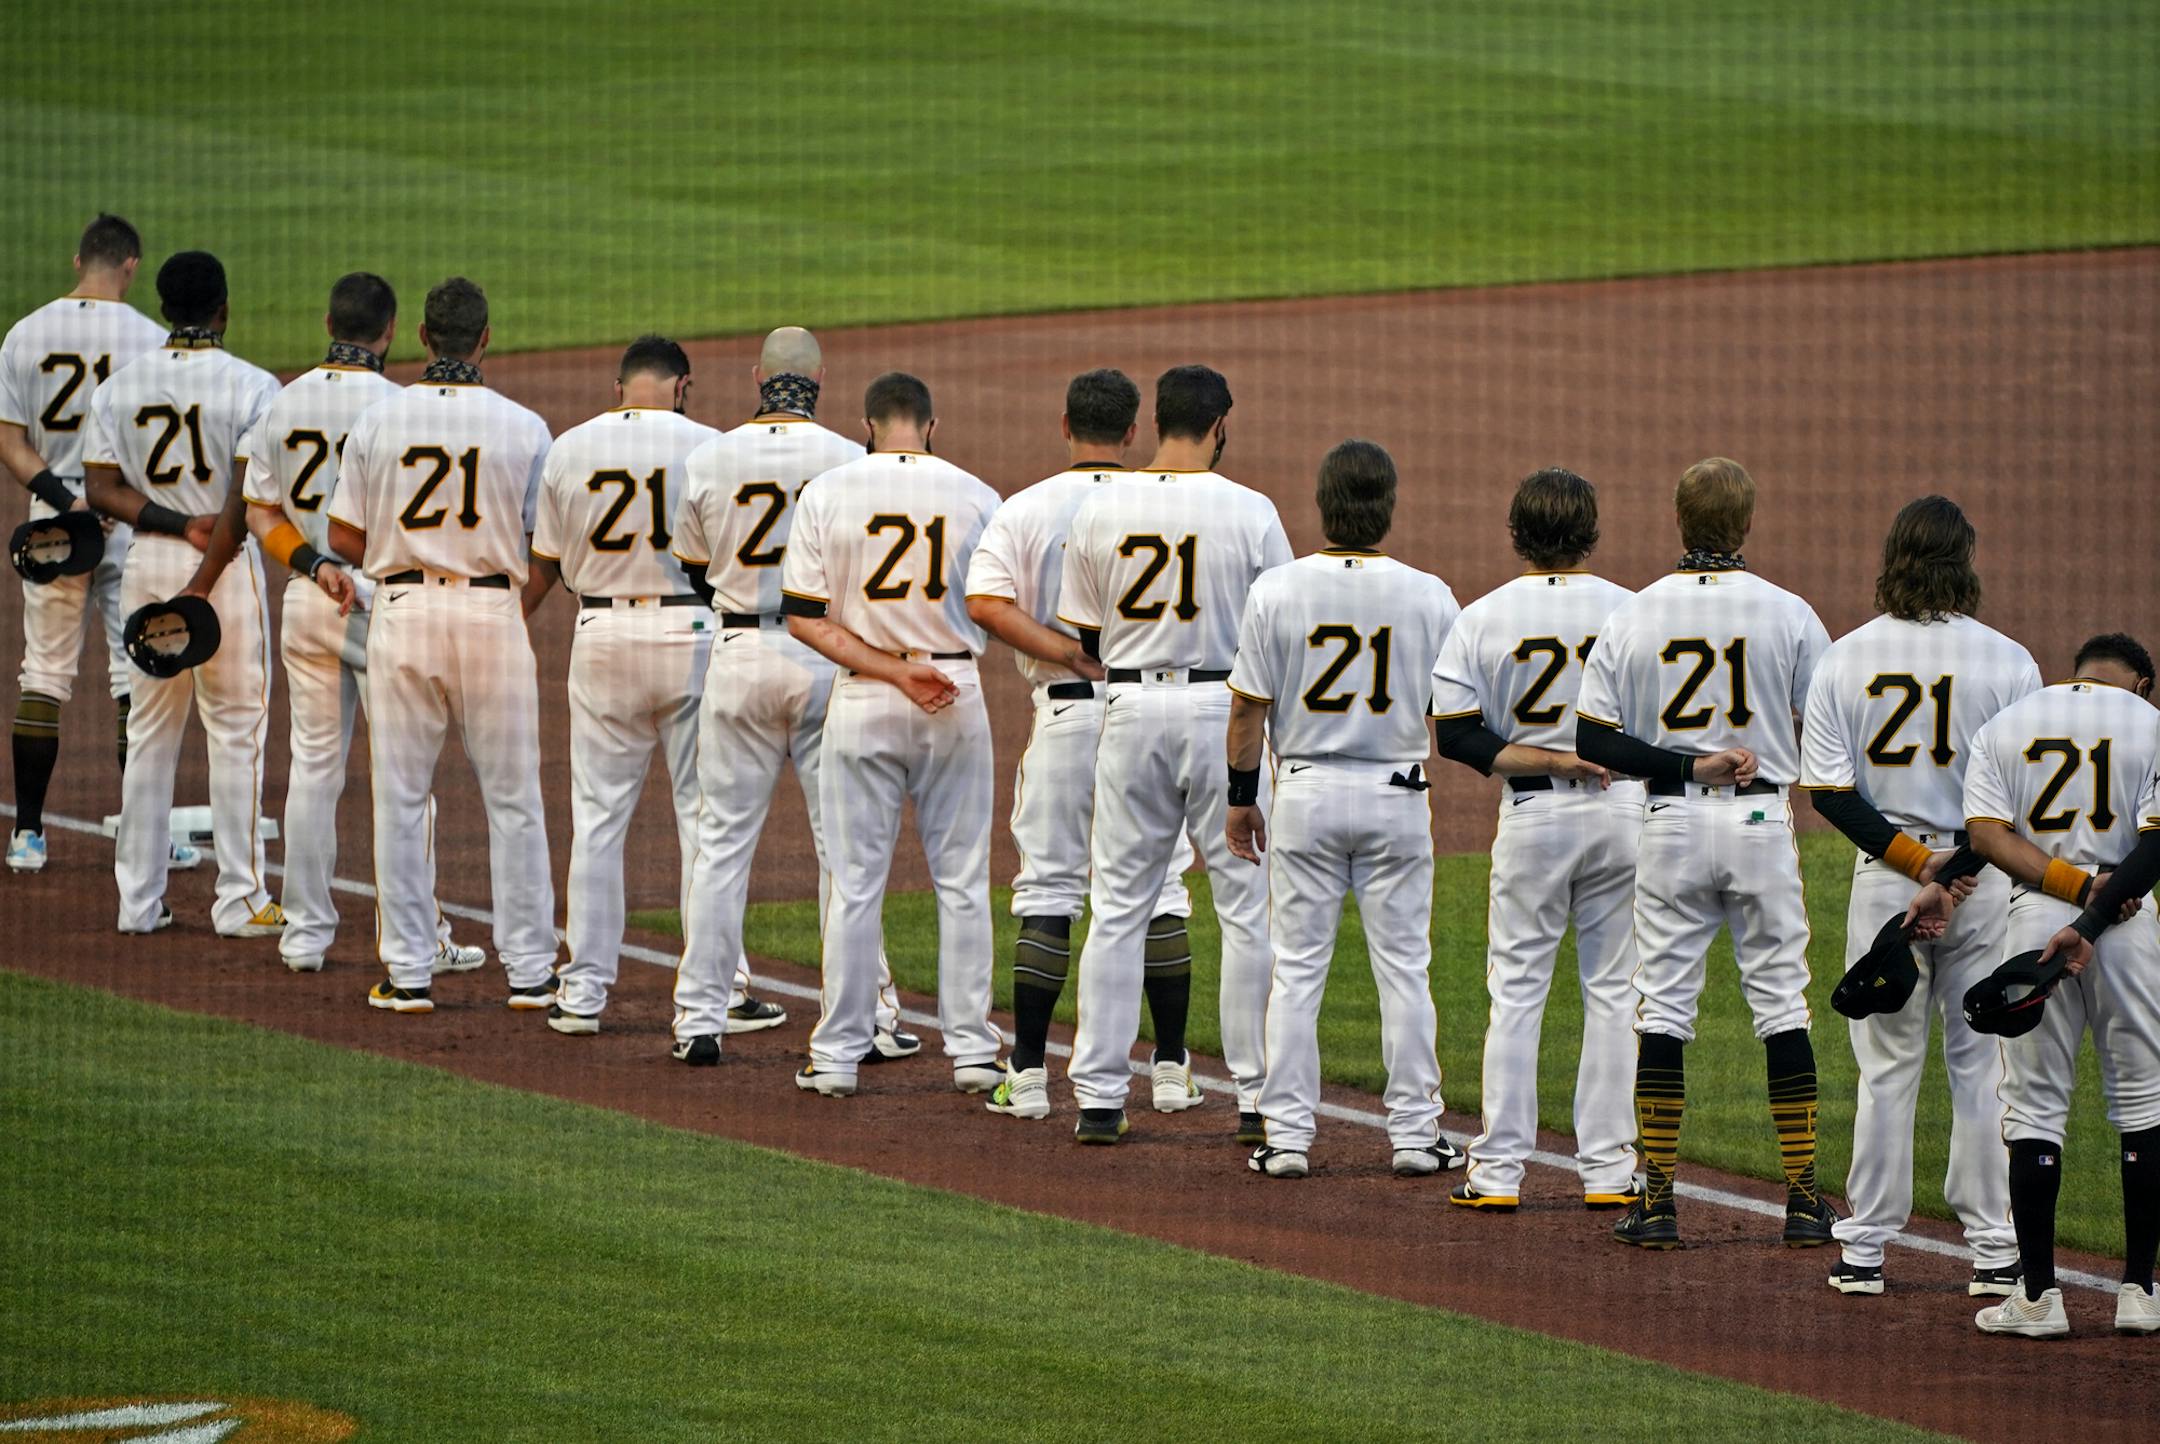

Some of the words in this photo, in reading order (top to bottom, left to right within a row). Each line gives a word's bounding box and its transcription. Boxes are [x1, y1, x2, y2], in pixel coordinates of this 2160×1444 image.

[135, 404, 213, 488] 21
[284, 429, 348, 513] 2
[398, 446, 483, 532] 21
[586, 468, 673, 555] 21
[734, 480, 805, 569] 2
[862, 513, 948, 602] 21
[1116, 534, 1201, 623] 21
[1302, 624, 1393, 715] 21
[1511, 636, 1598, 726] 2
[1659, 637, 1754, 732] 21
[1865, 673, 1957, 768] 21
[2023, 737, 2117, 834] 21
